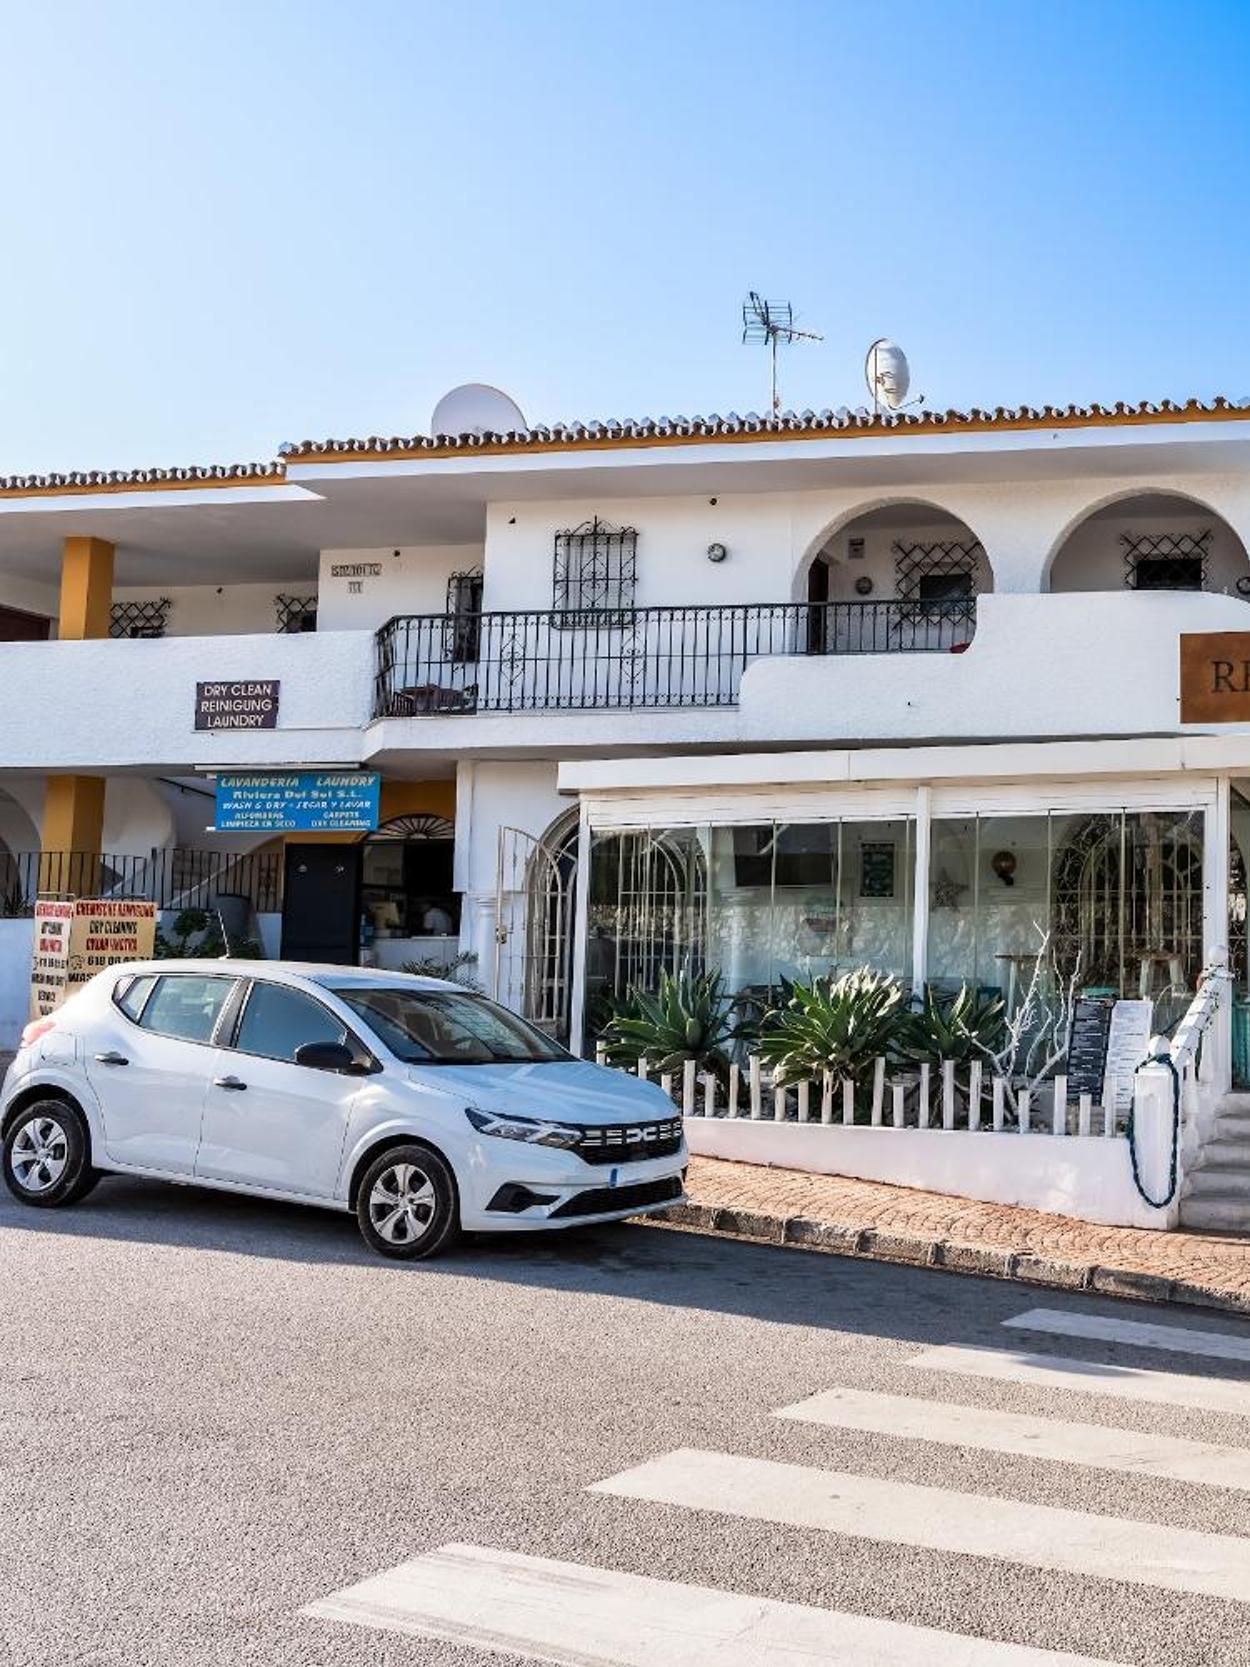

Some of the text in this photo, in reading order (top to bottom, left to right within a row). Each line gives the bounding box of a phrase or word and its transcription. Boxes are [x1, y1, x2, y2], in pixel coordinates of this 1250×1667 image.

[204, 684, 273, 697] DRY CLEAN
[201, 699, 273, 713] REINIGUNG
[207, 714, 265, 728] LAUNDRY
[220, 775, 376, 788] LAVANDERIA LAUNDRY
[266, 801, 288, 809] DRY
